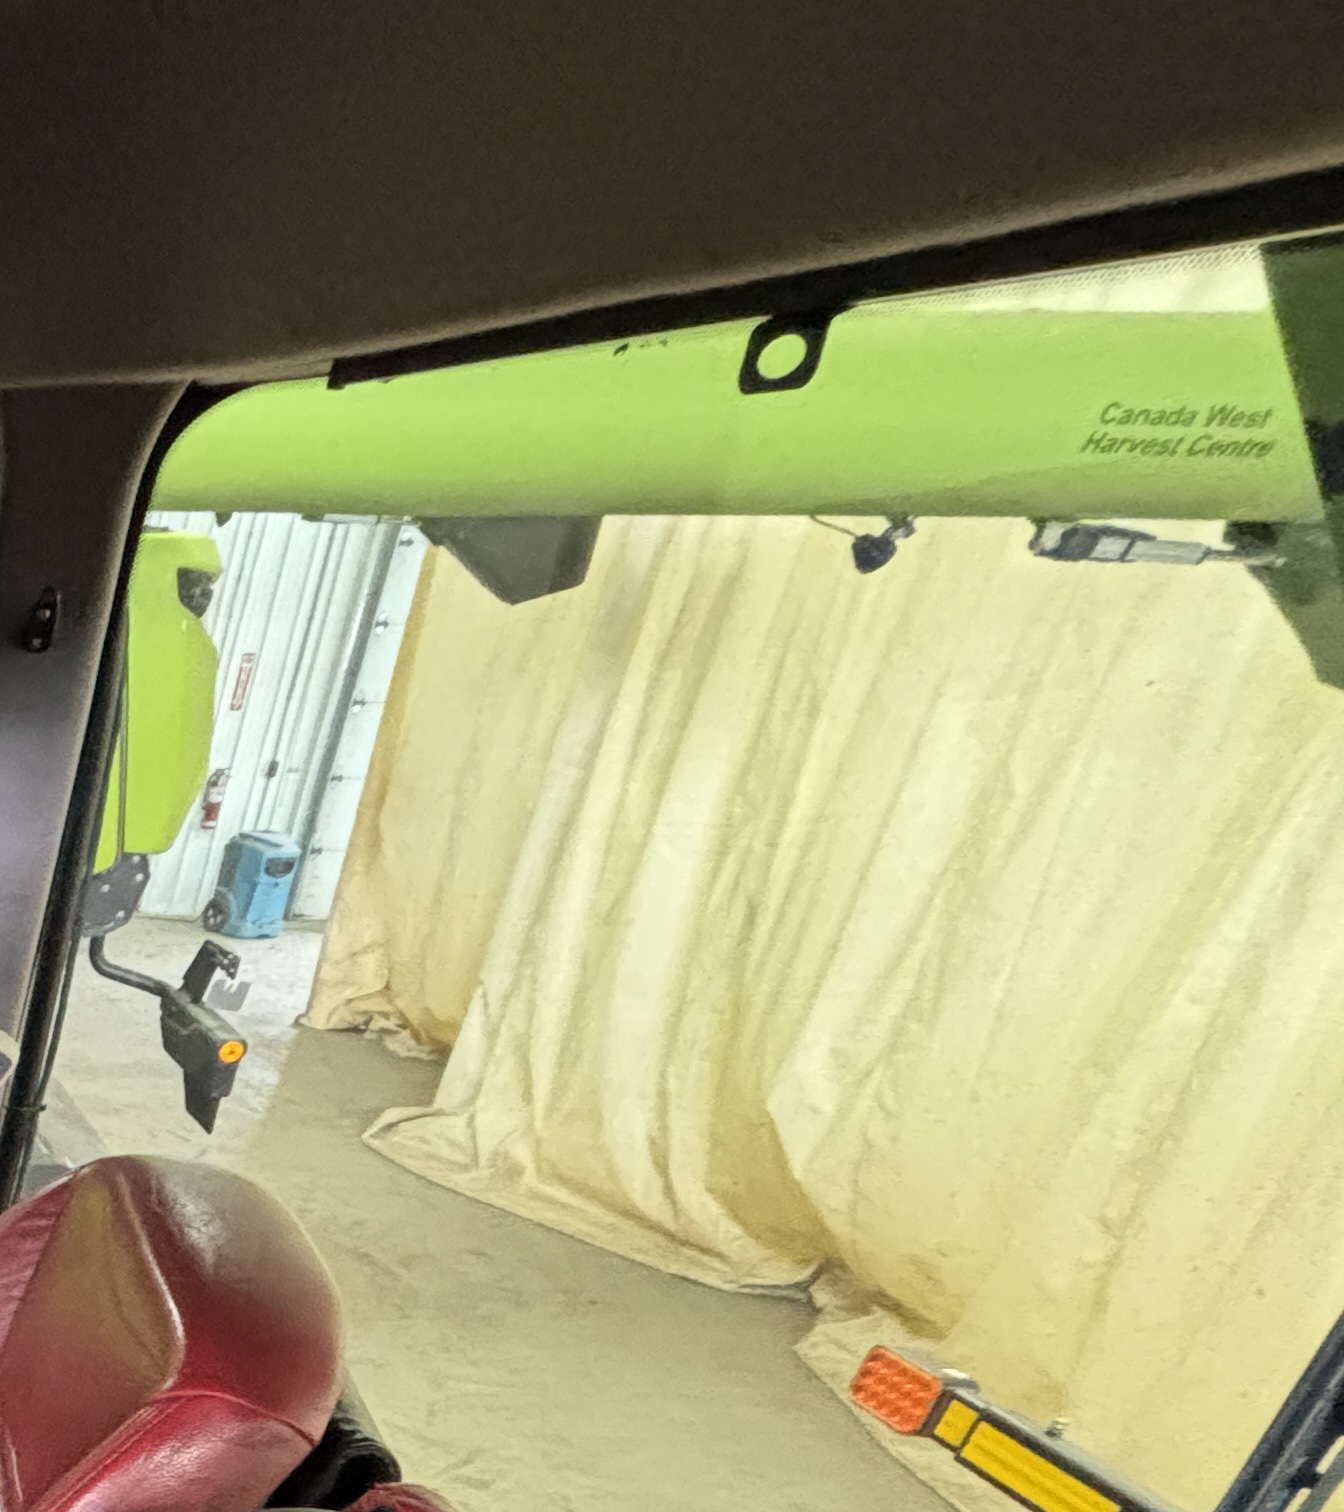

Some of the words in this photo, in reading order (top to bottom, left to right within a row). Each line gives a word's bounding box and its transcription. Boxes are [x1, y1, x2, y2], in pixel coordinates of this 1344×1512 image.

[1100, 402, 1198, 428] Canada
[1204, 404, 1273, 428] West
[1080, 430, 1184, 457] Harvest
[1187, 433, 1279, 459] Centre
